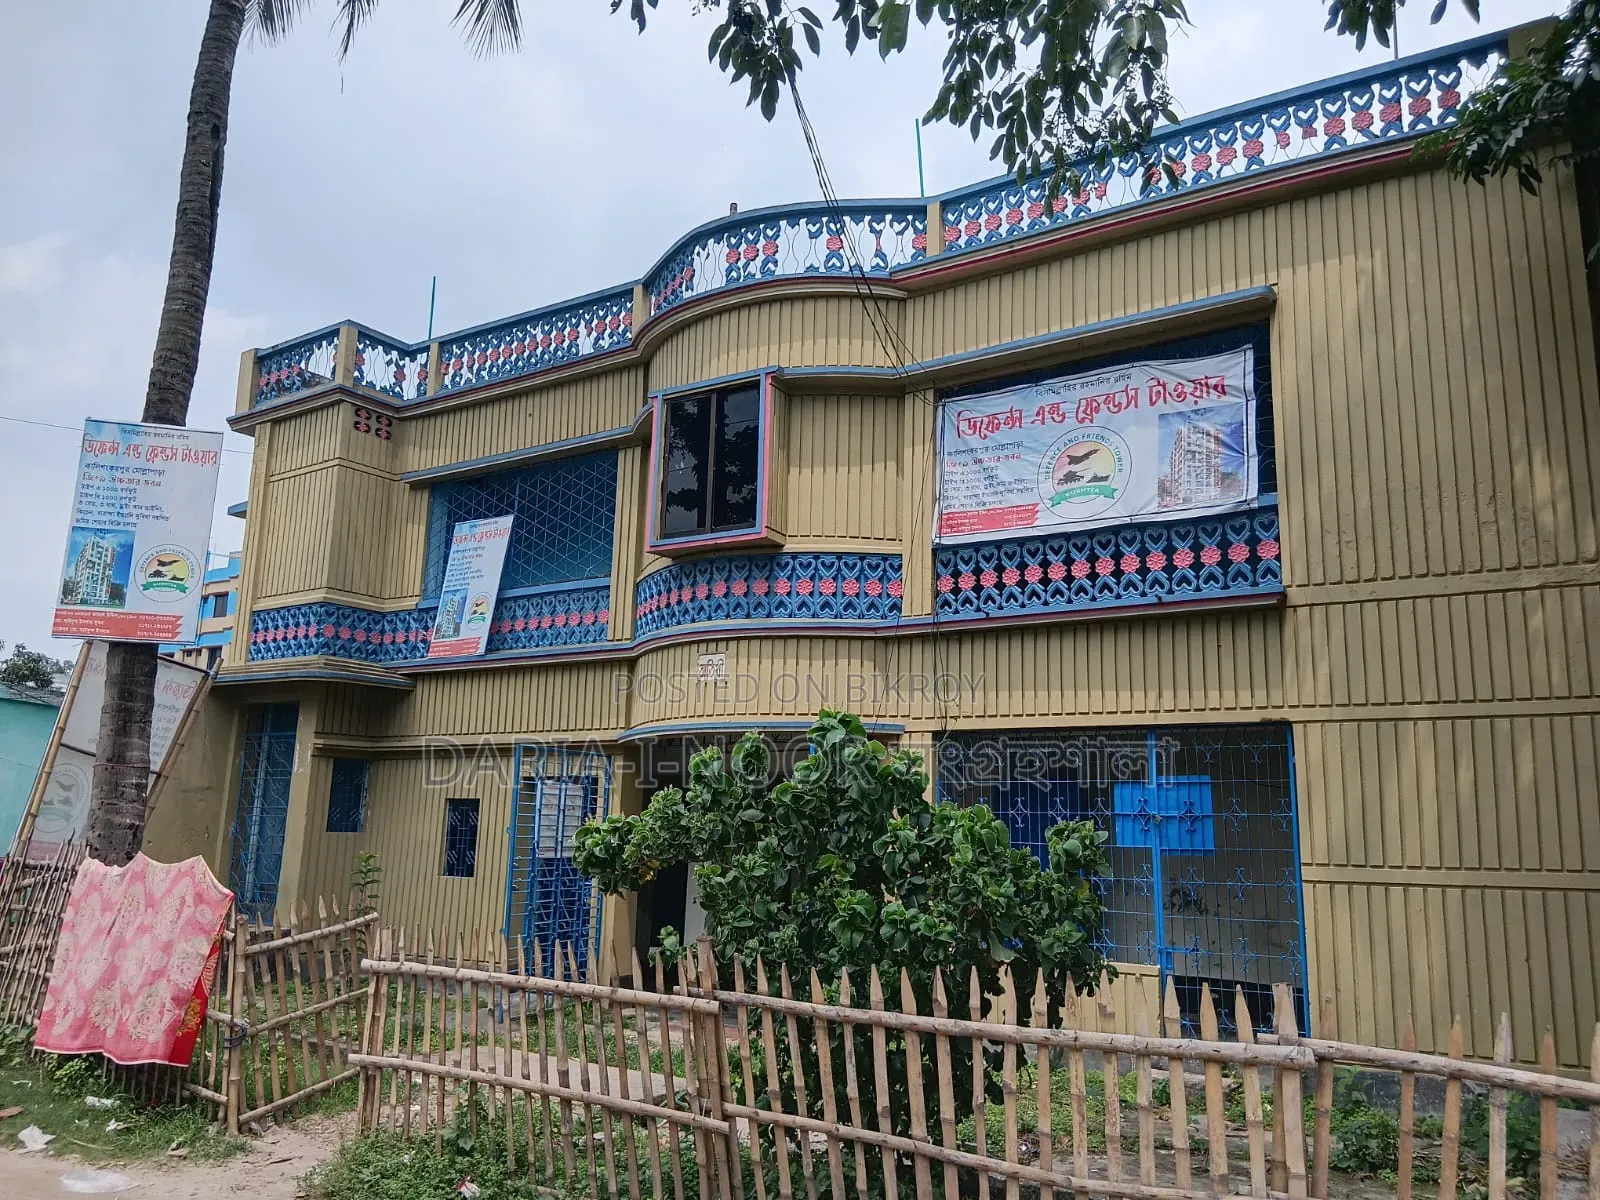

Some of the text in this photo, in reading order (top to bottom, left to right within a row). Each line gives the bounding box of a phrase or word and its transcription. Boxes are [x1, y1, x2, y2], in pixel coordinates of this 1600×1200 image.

[957, 405, 1023, 440] ডিফেন্স
[1031, 401, 1067, 425] এন্ড
[1145, 376, 1227, 407] টাওয়ার
[1063, 435, 1080, 447] AND
[1081, 432, 1115, 447] FRIENDS
[122, 443, 143, 458] এন্ড
[180, 444, 219, 468] টাওয়ার
